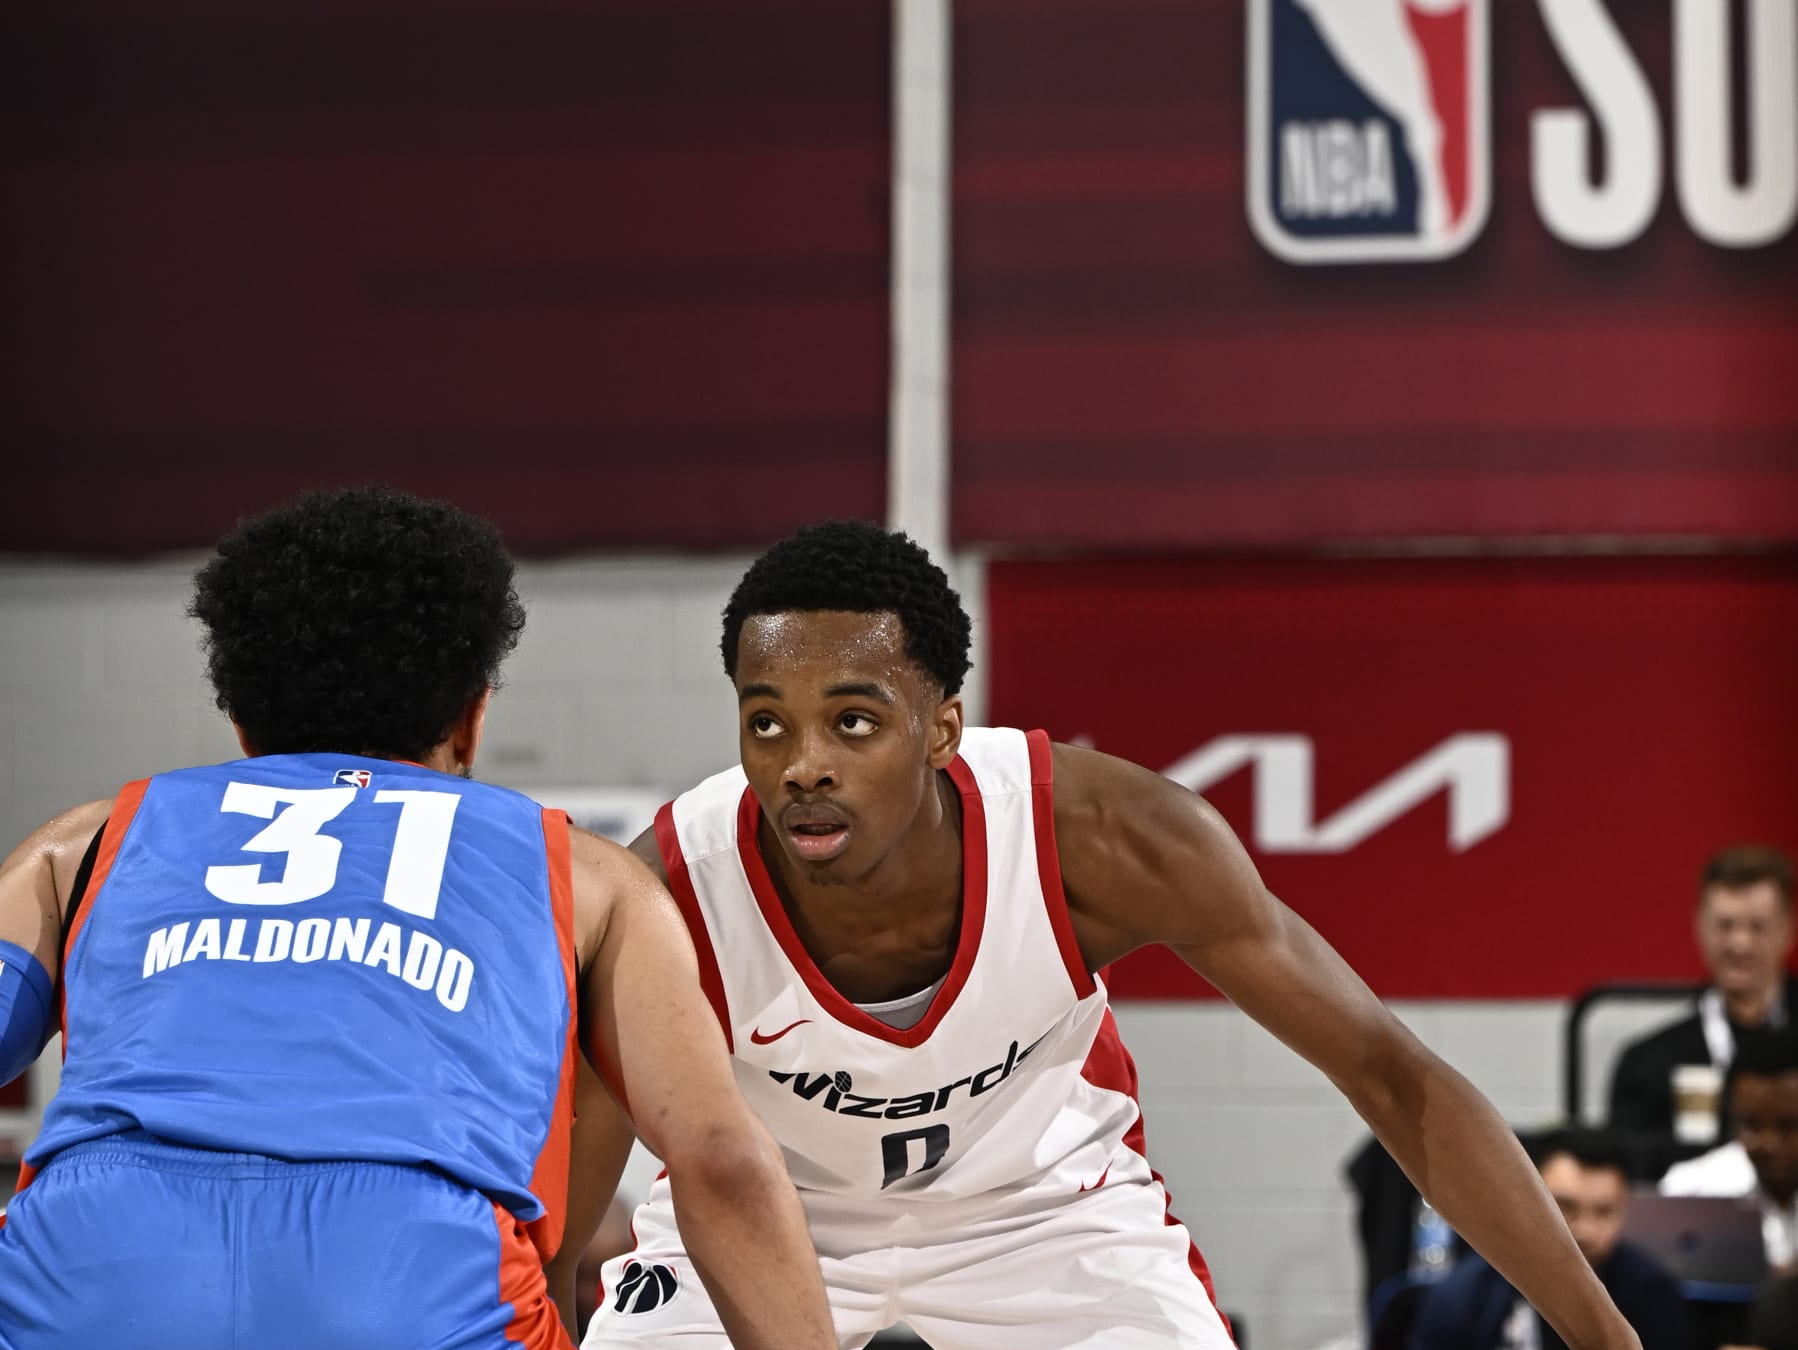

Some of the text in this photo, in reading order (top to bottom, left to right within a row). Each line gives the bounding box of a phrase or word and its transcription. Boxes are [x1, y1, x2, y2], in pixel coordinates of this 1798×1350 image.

[1281, 119, 1397, 219] NBA
[204, 781, 462, 920] 31
[142, 917, 475, 1013] MALDONADO
